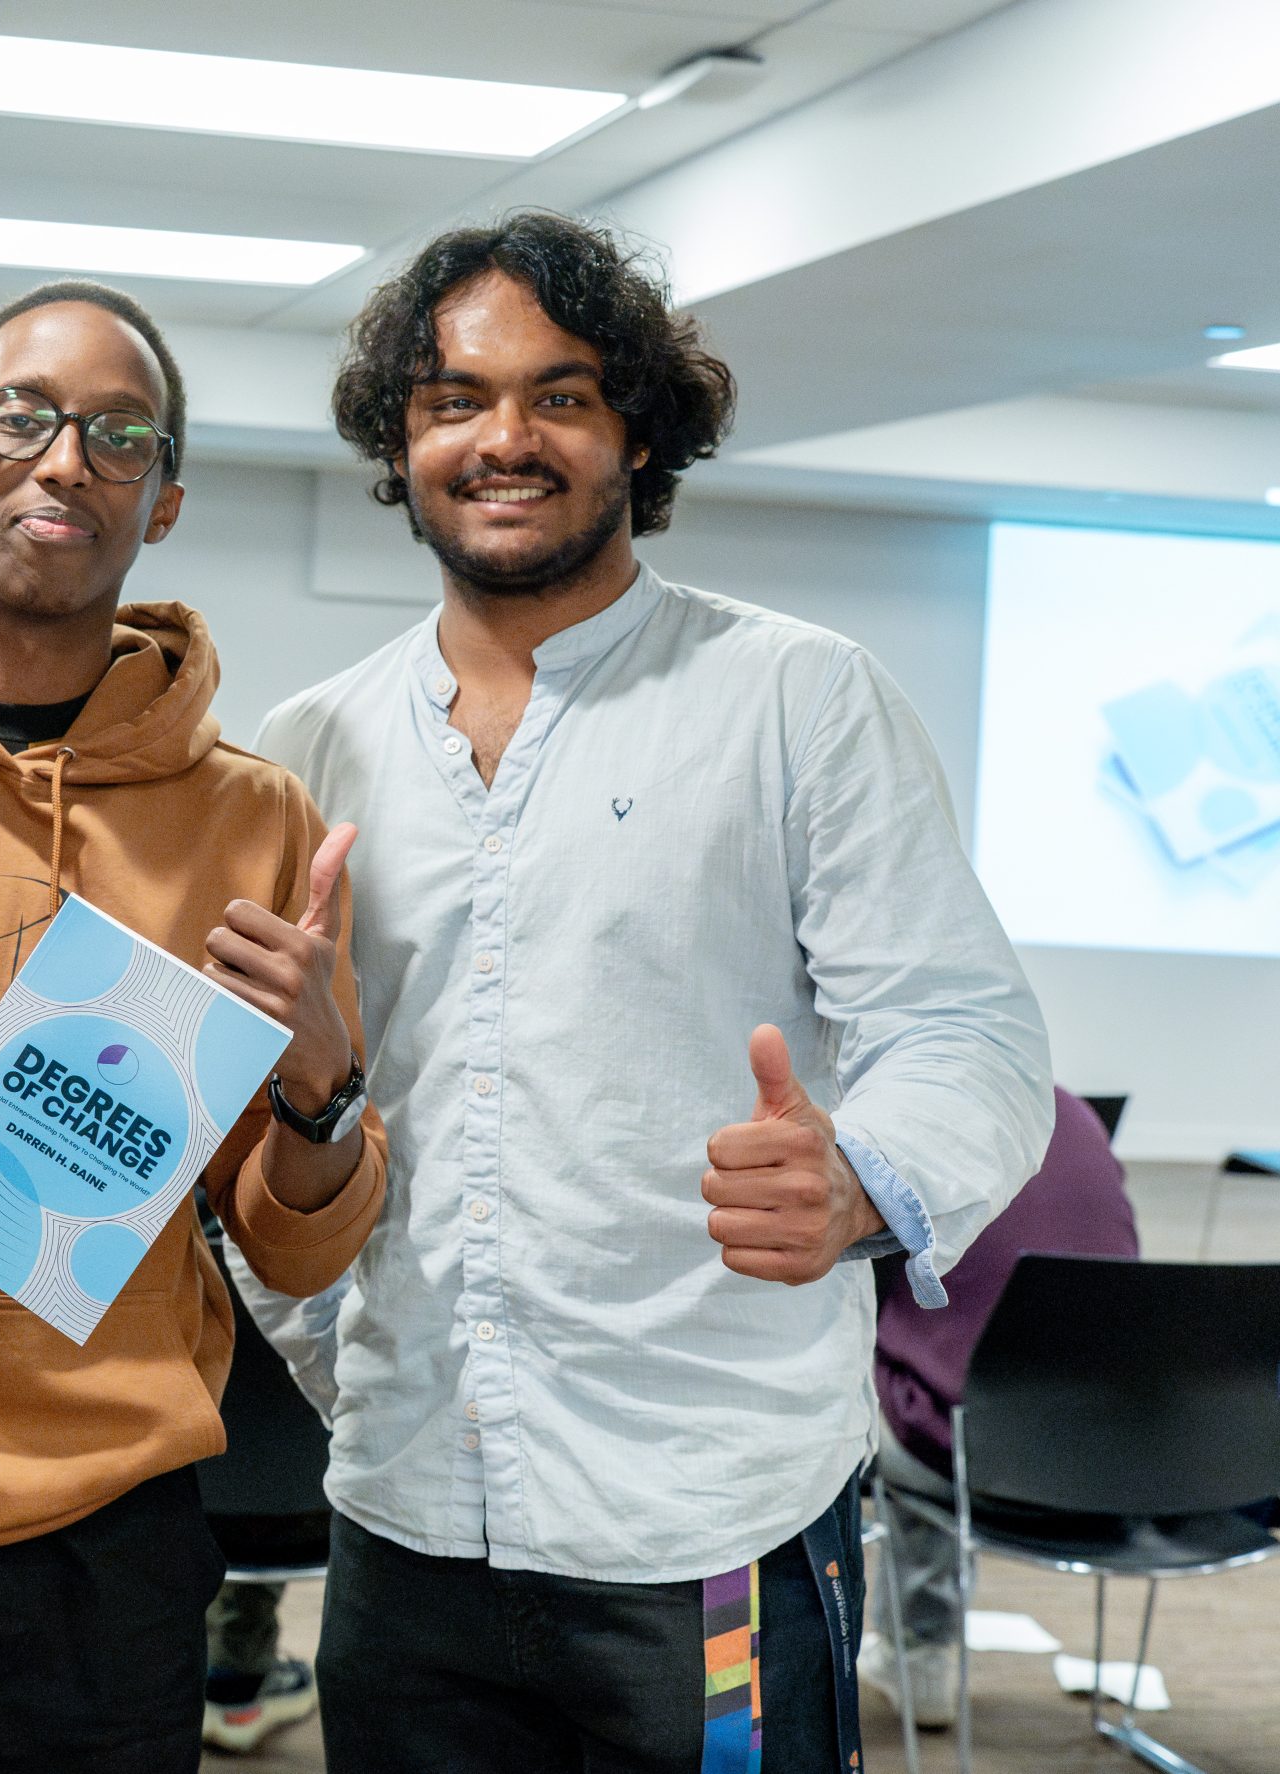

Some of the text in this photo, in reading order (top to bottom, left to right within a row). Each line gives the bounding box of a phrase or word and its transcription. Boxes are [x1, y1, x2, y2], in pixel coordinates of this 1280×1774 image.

[2, 1070, 159, 1180] OF CHANGE
[13, 1043, 172, 1158] DEGREES
[6, 1121, 108, 1192] DARREN H. BAINE
[8, 1101, 58, 1136] Entrepreneurship
[58, 1133, 69, 1143] The
[69, 1140, 81, 1151] Key
[81, 1147, 89, 1156] To
[88, 1153, 118, 1176] Changing
[118, 1172, 129, 1182] The
[129, 1180, 151, 1196] World?
[831, 1579, 847, 1637] WATERLOO
